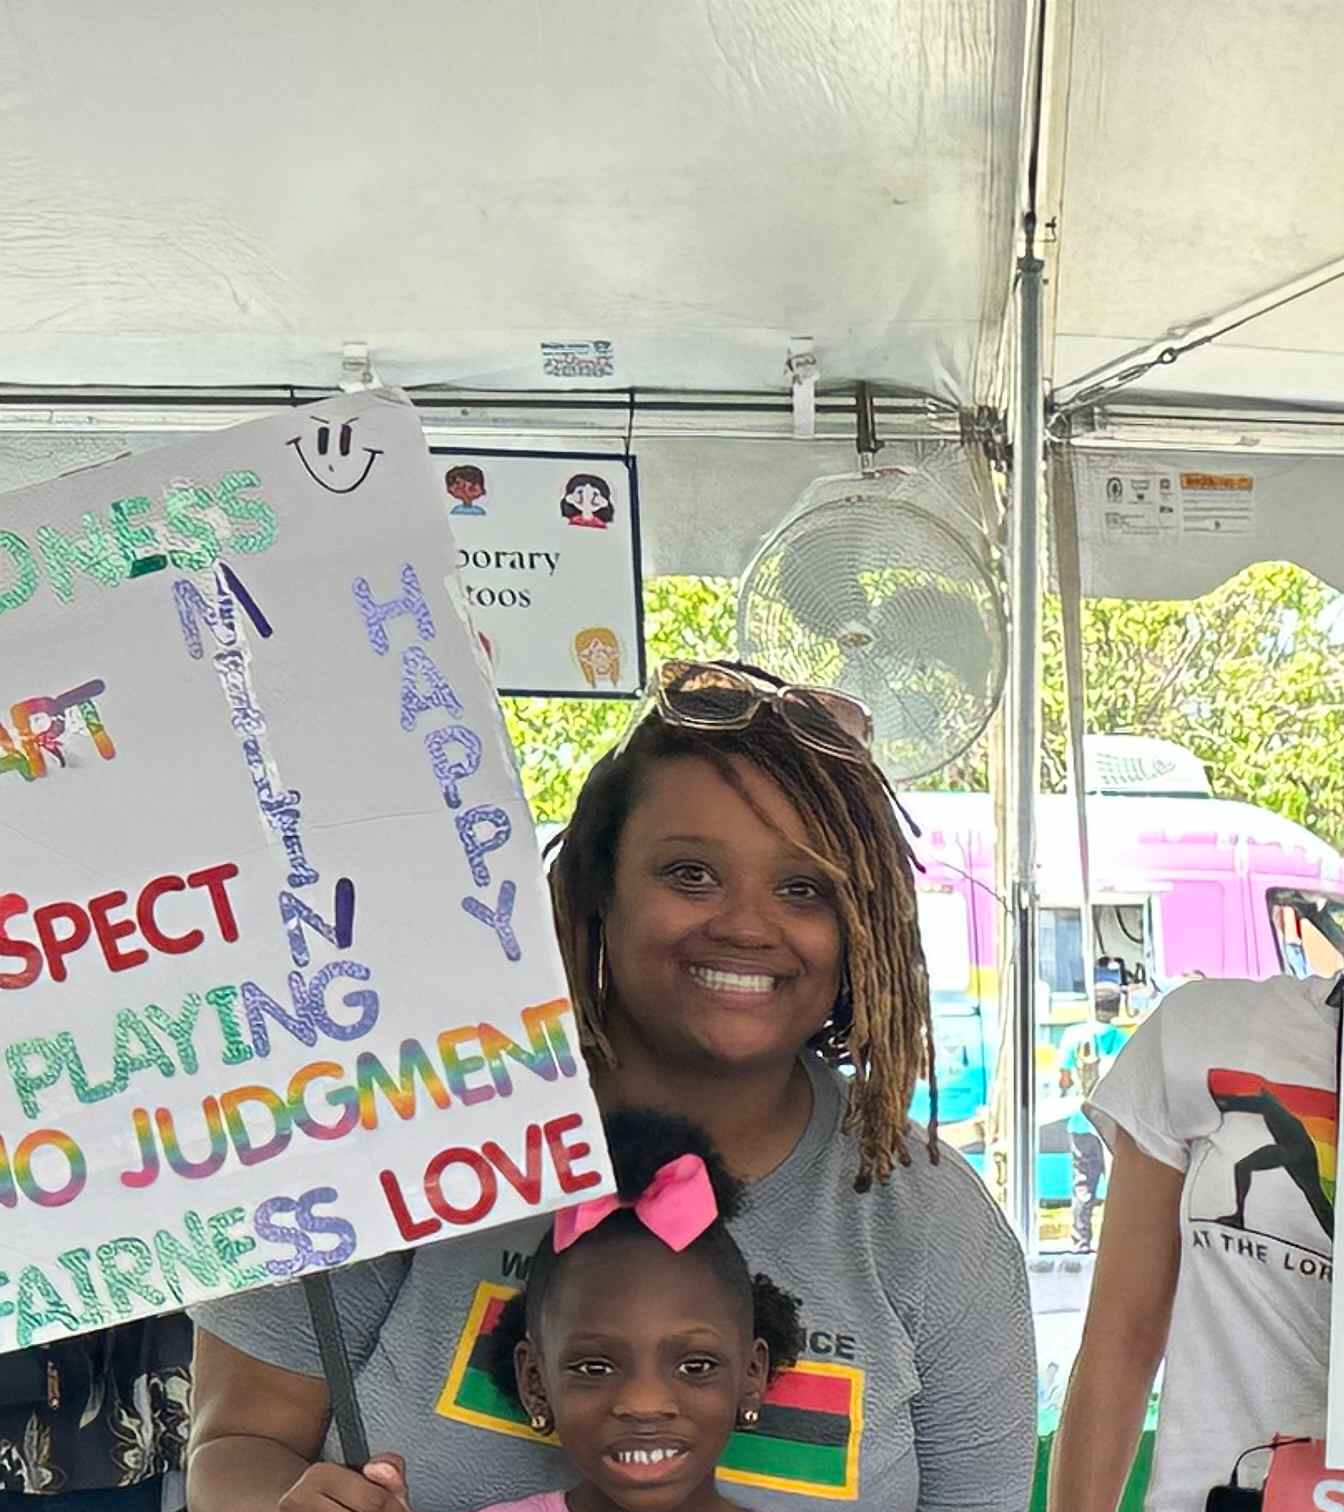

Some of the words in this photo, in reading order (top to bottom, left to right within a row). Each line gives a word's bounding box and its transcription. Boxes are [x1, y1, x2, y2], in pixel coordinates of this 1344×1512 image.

[4, 958, 379, 1120] PLAYING
[120, 997, 577, 1189] JUDGMENT
[379, 1113, 602, 1242] LOVE
[1221, 1234, 1267, 1263] THE
[1284, 1253, 1333, 1282] LOR
